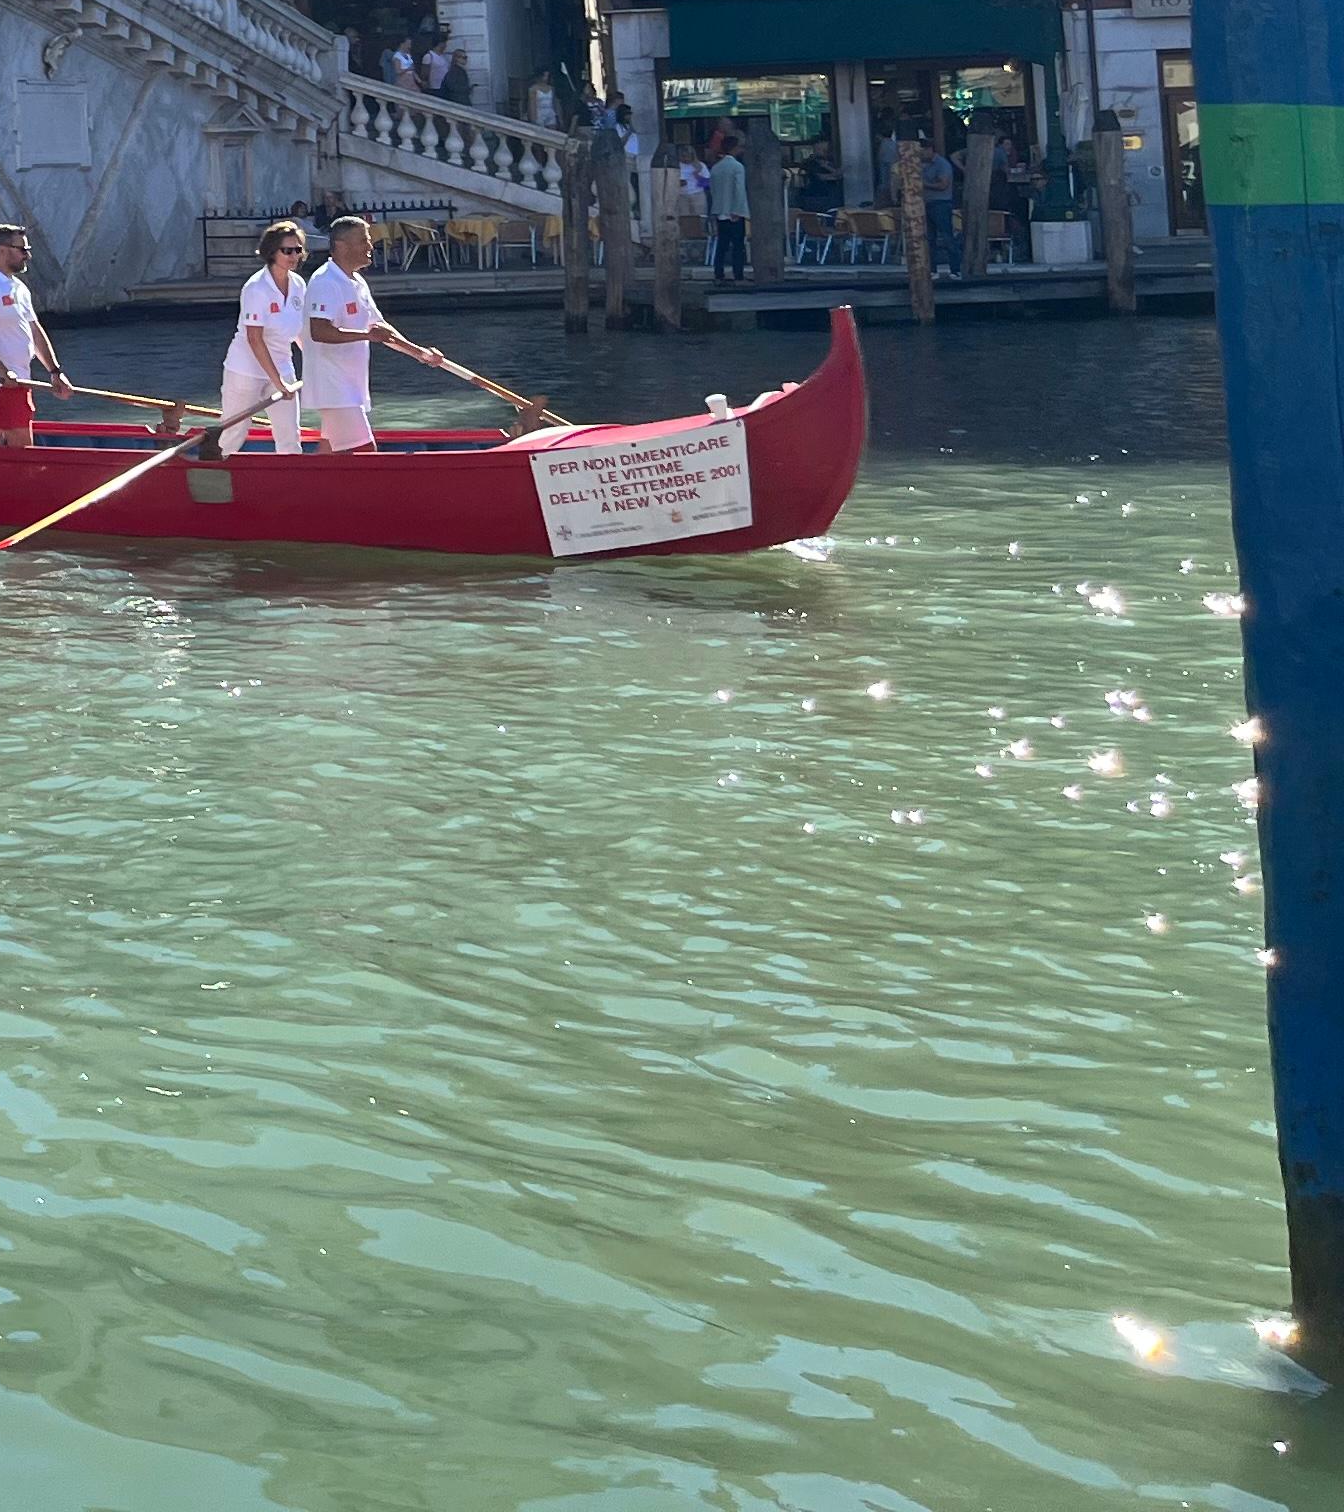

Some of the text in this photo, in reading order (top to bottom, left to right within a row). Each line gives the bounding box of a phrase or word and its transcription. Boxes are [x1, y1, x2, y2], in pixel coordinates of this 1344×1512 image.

[549, 435, 730, 476] PER NON DIMENTICARE
[598, 460, 685, 484] LE VITTIME
[549, 463, 742, 506] DELL'11 SETTEMBRE 2001
[601, 501, 611, 514] A
[615, 496, 650, 512] NEW
[655, 487, 701, 506] YORK
